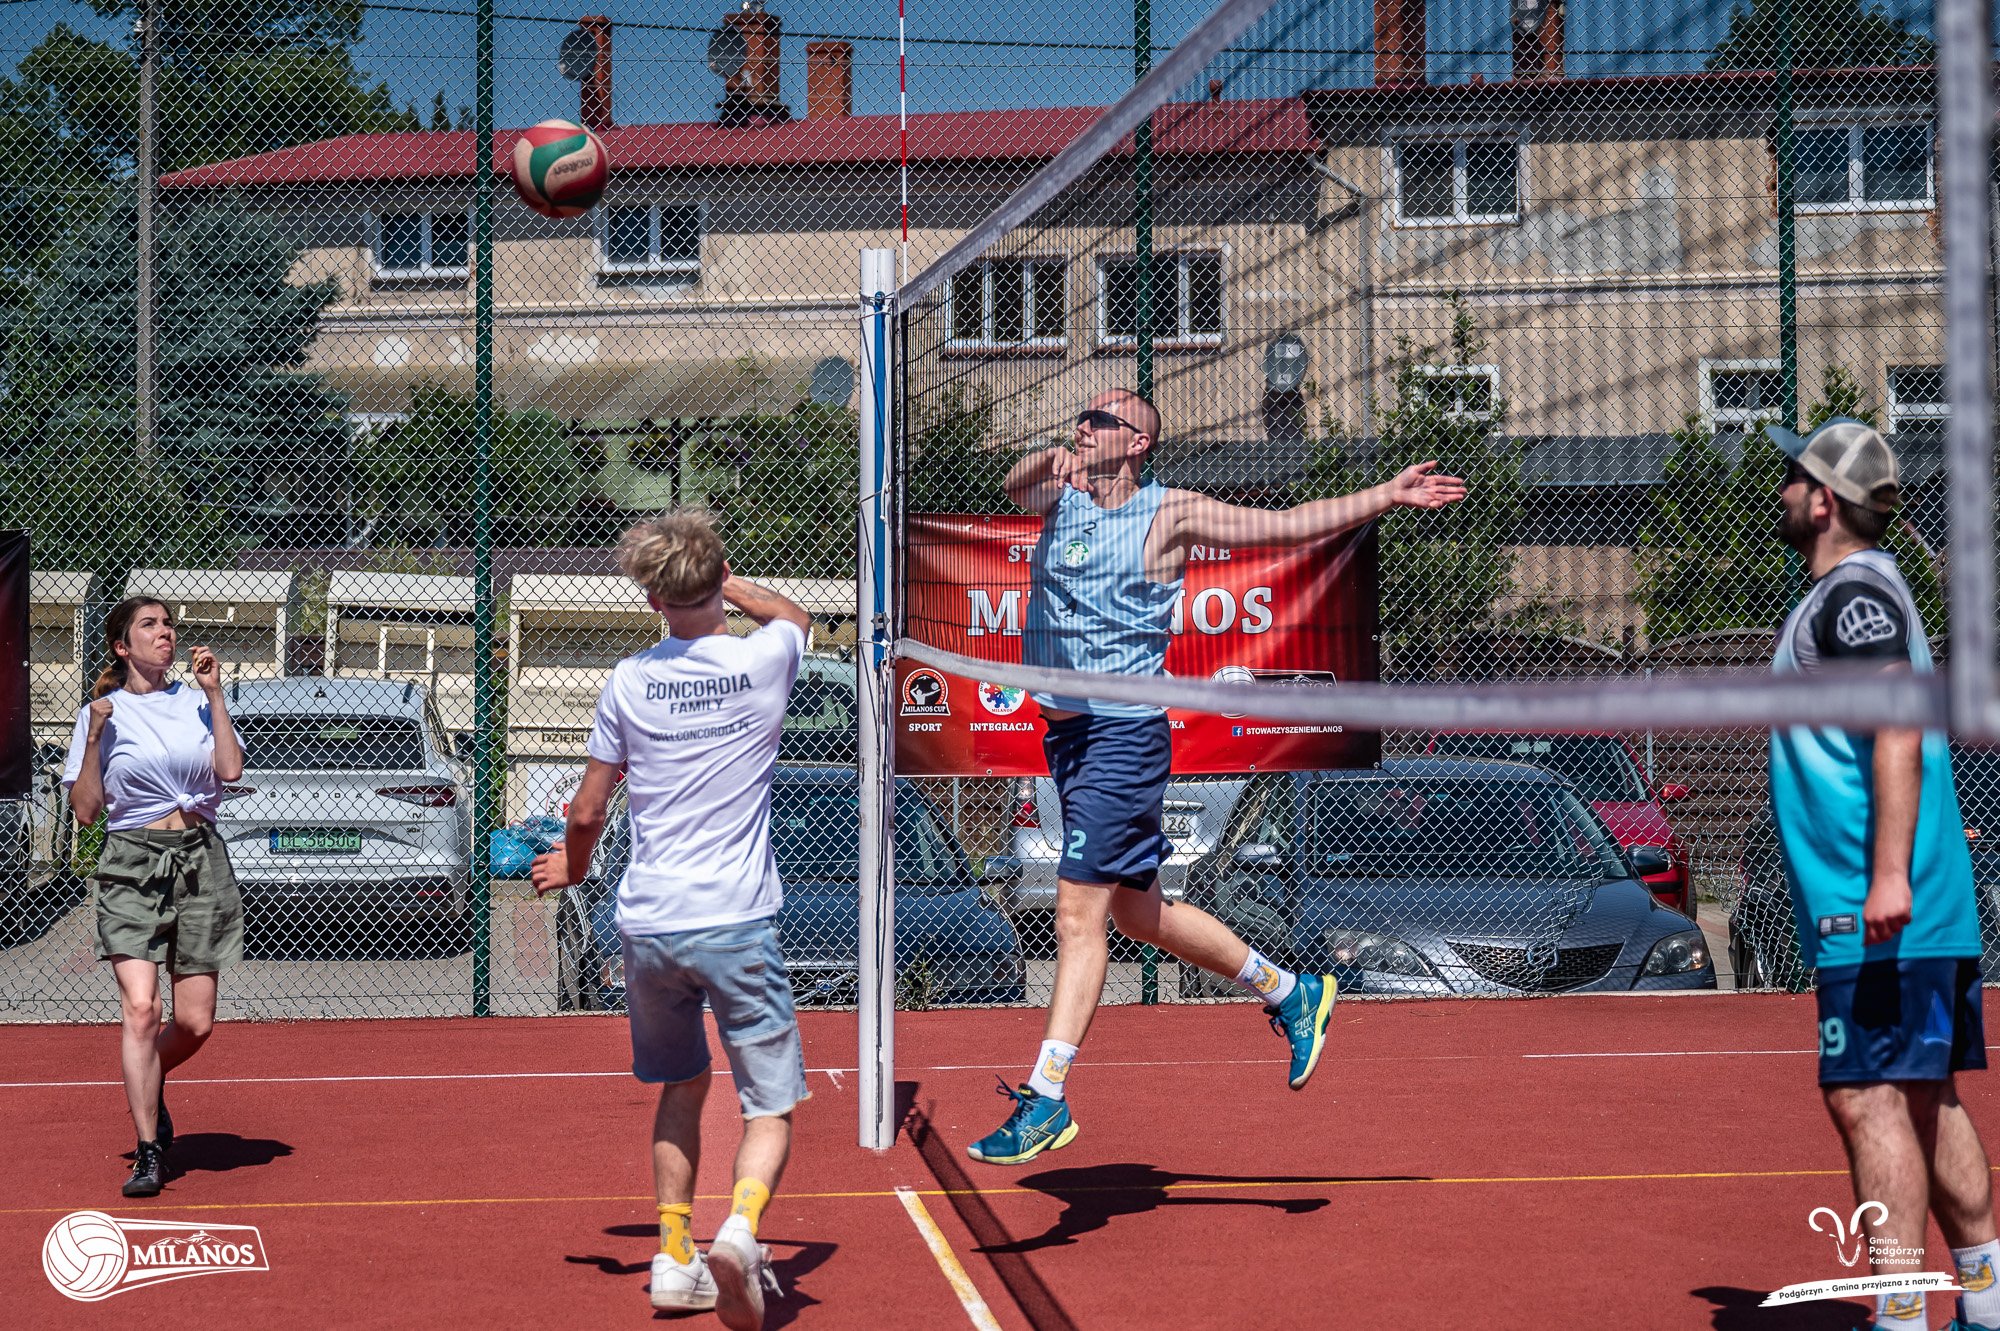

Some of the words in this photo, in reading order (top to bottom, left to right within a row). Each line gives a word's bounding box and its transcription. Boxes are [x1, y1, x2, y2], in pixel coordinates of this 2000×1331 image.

[646, 673, 752, 700] CONCORDIA
[670, 698, 724, 715] FAMILY
[905, 705, 933, 713] MILANOS
[933, 705, 946, 713] CUP
[908, 723, 942, 732] SPORT
[969, 722, 1034, 732] INTEGRACJA
[1246, 725, 1343, 735] STOWARZYSZENIEMILANOS
[1066, 829, 1087, 860] 2
